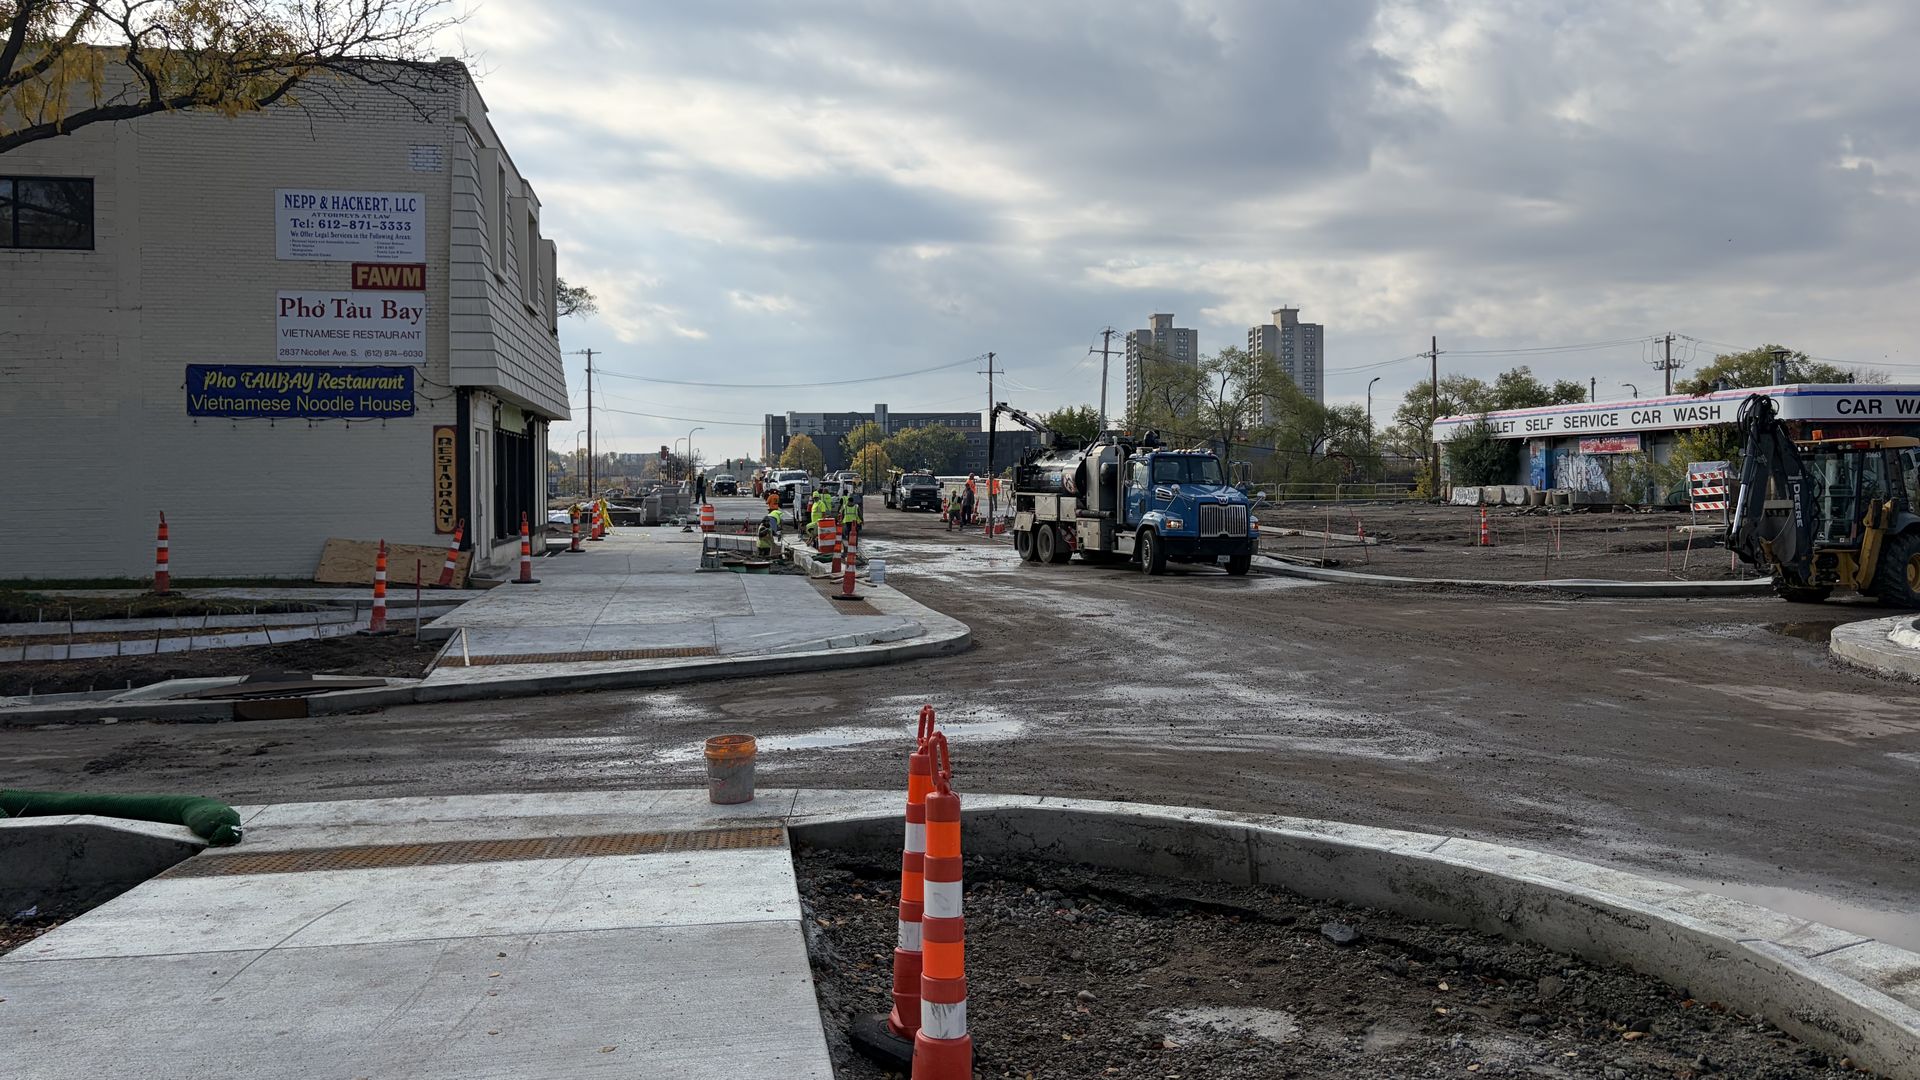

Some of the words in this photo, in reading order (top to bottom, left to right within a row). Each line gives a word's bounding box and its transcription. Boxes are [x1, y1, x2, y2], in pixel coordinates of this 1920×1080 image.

[284, 194, 316, 210] NEPP
[320, 195, 329, 210] &
[332, 196, 392, 213] HACKERT,
[395, 198, 417, 212] LLC
[290, 218, 314, 229] Tel:
[318, 219, 412, 231] 612-871-3333
[290, 230, 299, 238] We
[300, 230, 314, 238] Offer
[315, 231, 330, 239] Legal
[330, 231, 353, 239] Services
[369, 232, 394, 241] Following
[356, 266, 421, 288] FAWM
[331, 298, 372, 319] Tàu
[381, 299, 424, 325] Bay
[282, 329, 351, 339] VIETNAMESE
[352, 330, 421, 340] RESTAURANT
[280, 348, 301, 357] 2837
[301, 349, 330, 357] Nicollet
[332, 350, 349, 358] Ave.
[350, 350, 360, 358] S.
[365, 349, 383, 359] (612)
[204, 371, 236, 390] Pho
[240, 371, 314, 393] TAUBAY
[317, 372, 405, 390] Restaurant
[191, 394, 291, 411] Vietnamese
[296, 395, 354, 411] Noodle
[360, 395, 411, 411] House
[1837, 399, 1882, 414] CAR
[1525, 418, 1553, 431] SELF
[1563, 413, 1618, 429] SERVICE
[1631, 410, 1662, 424] CAR
[1673, 405, 1721, 422] WASH
[438, 437, 452, 524] RESTAURANT
[1793, 483, 1804, 528] DEERE
